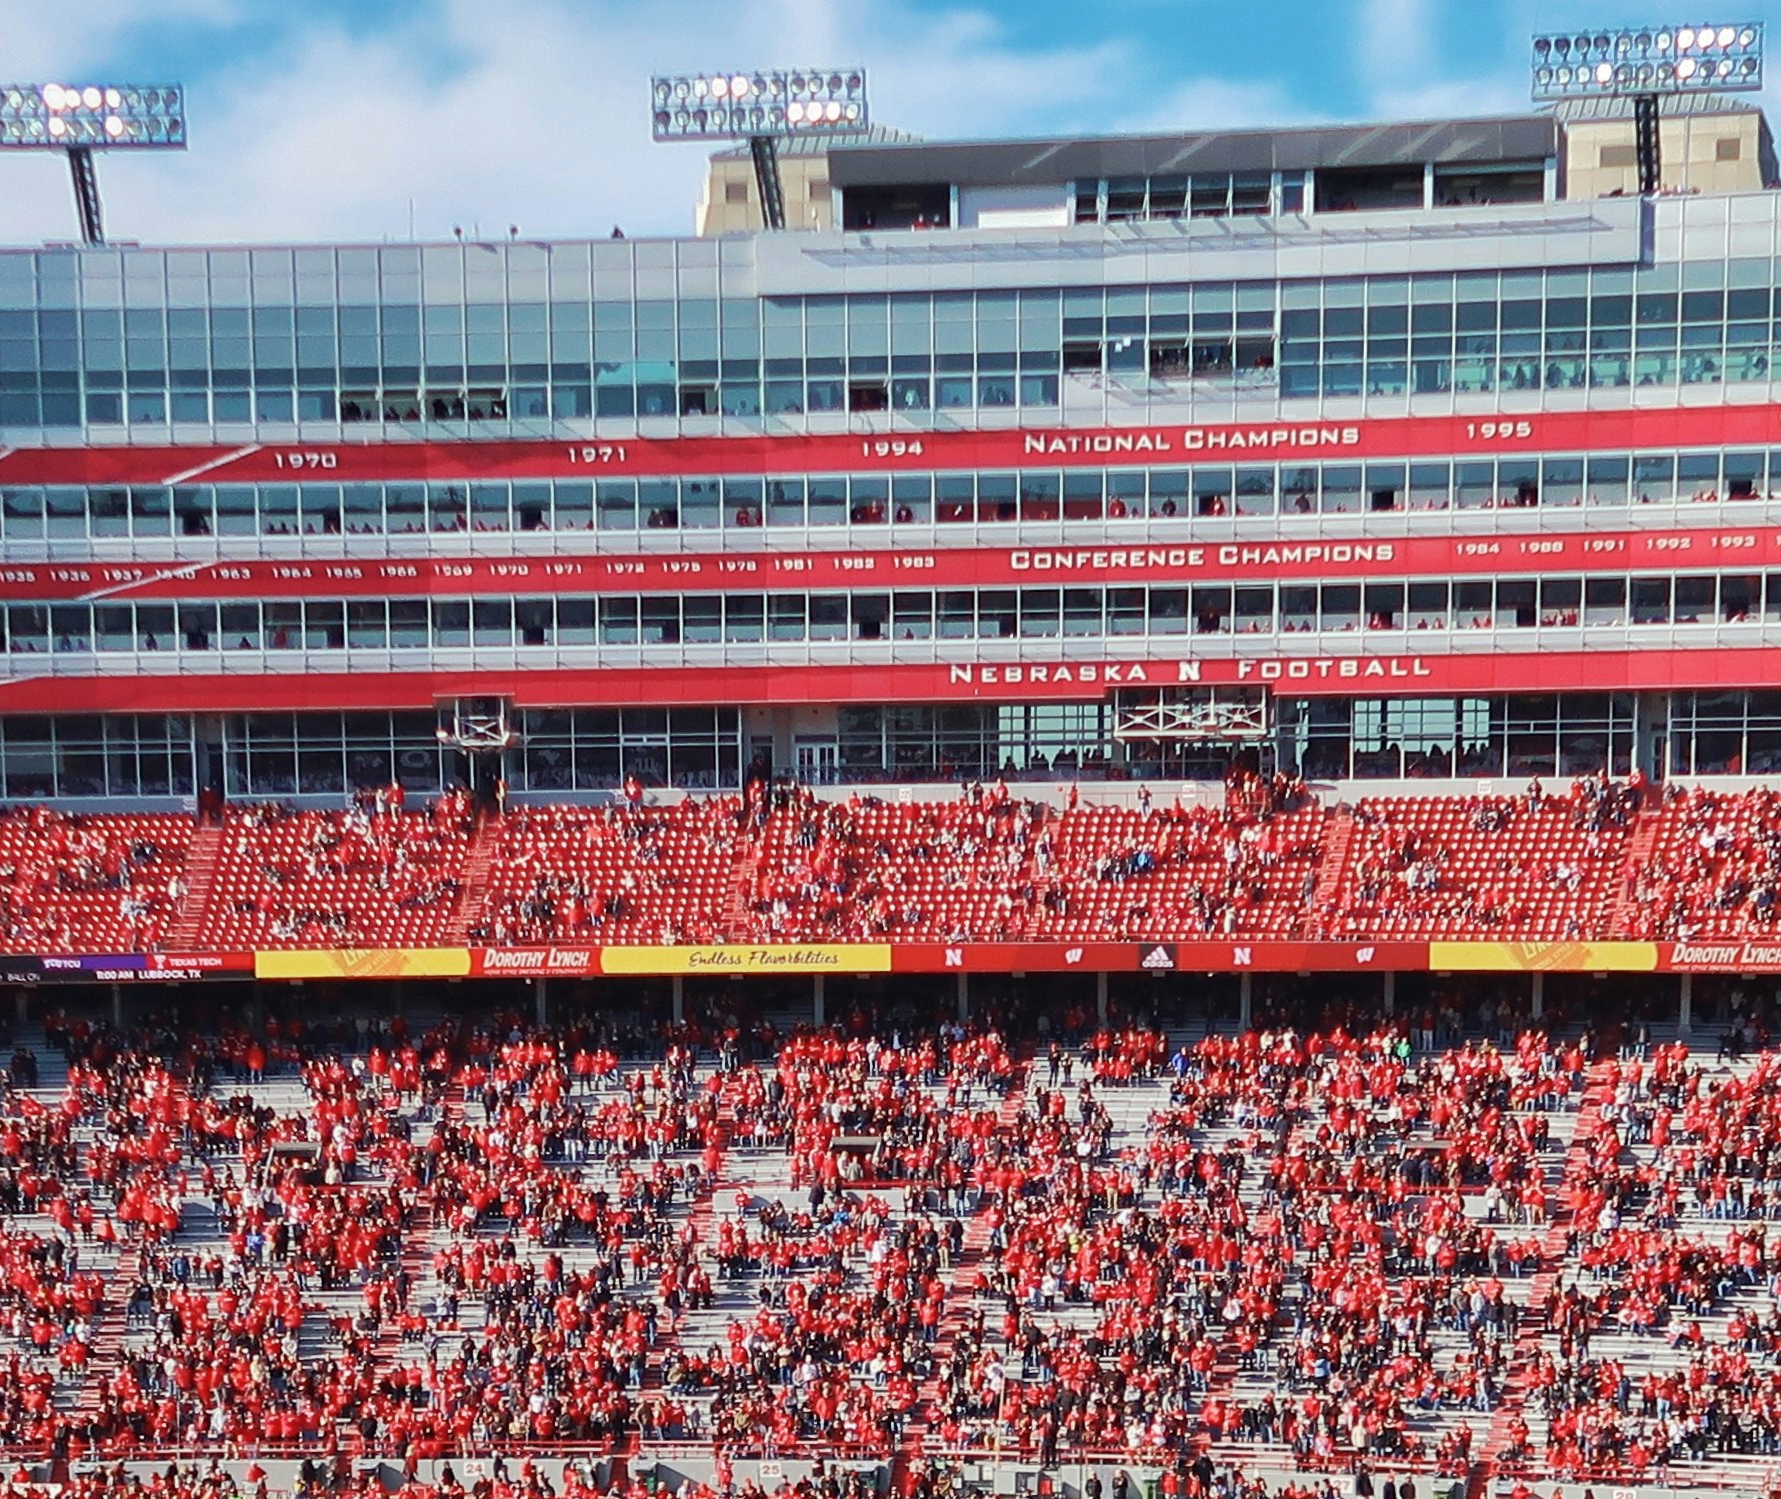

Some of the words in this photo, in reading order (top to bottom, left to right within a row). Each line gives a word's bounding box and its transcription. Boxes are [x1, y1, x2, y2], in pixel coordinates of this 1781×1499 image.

[1467, 421, 1532, 439] 1995
[862, 440, 924, 457] 1994
[1024, 434, 1171, 454] NATIONAL
[1183, 428, 1360, 451] CHAMPIONS
[274, 452, 338, 469] 1970
[568, 446, 626, 463] 1971
[1009, 544, 1204, 570] CONFERENCE
[1219, 543, 1394, 566] CHAMPIONS
[950, 663, 1147, 684] NEBRASKA
[1178, 661, 1201, 682] N
[1237, 657, 1432, 680] FOOTBALL
[483, 948, 547, 969] DOROTHY
[547, 948, 589, 968] LYNCH
[689, 950, 742, 967] Endless
[747, 949, 839, 967] Flavorbilities
[945, 948, 963, 967] N
[1064, 947, 1083, 965] W
[1233, 947, 1252, 966] N
[1356, 946, 1375, 963] W
[1671, 943, 1739, 964] DOROTHY
[169, 959, 199, 967] TEXAS
[200, 959, 223, 967] TECH
[118, 970, 135, 980] AM
[465, 1463, 483, 1475] 24
[762, 1464, 780, 1475] 25
